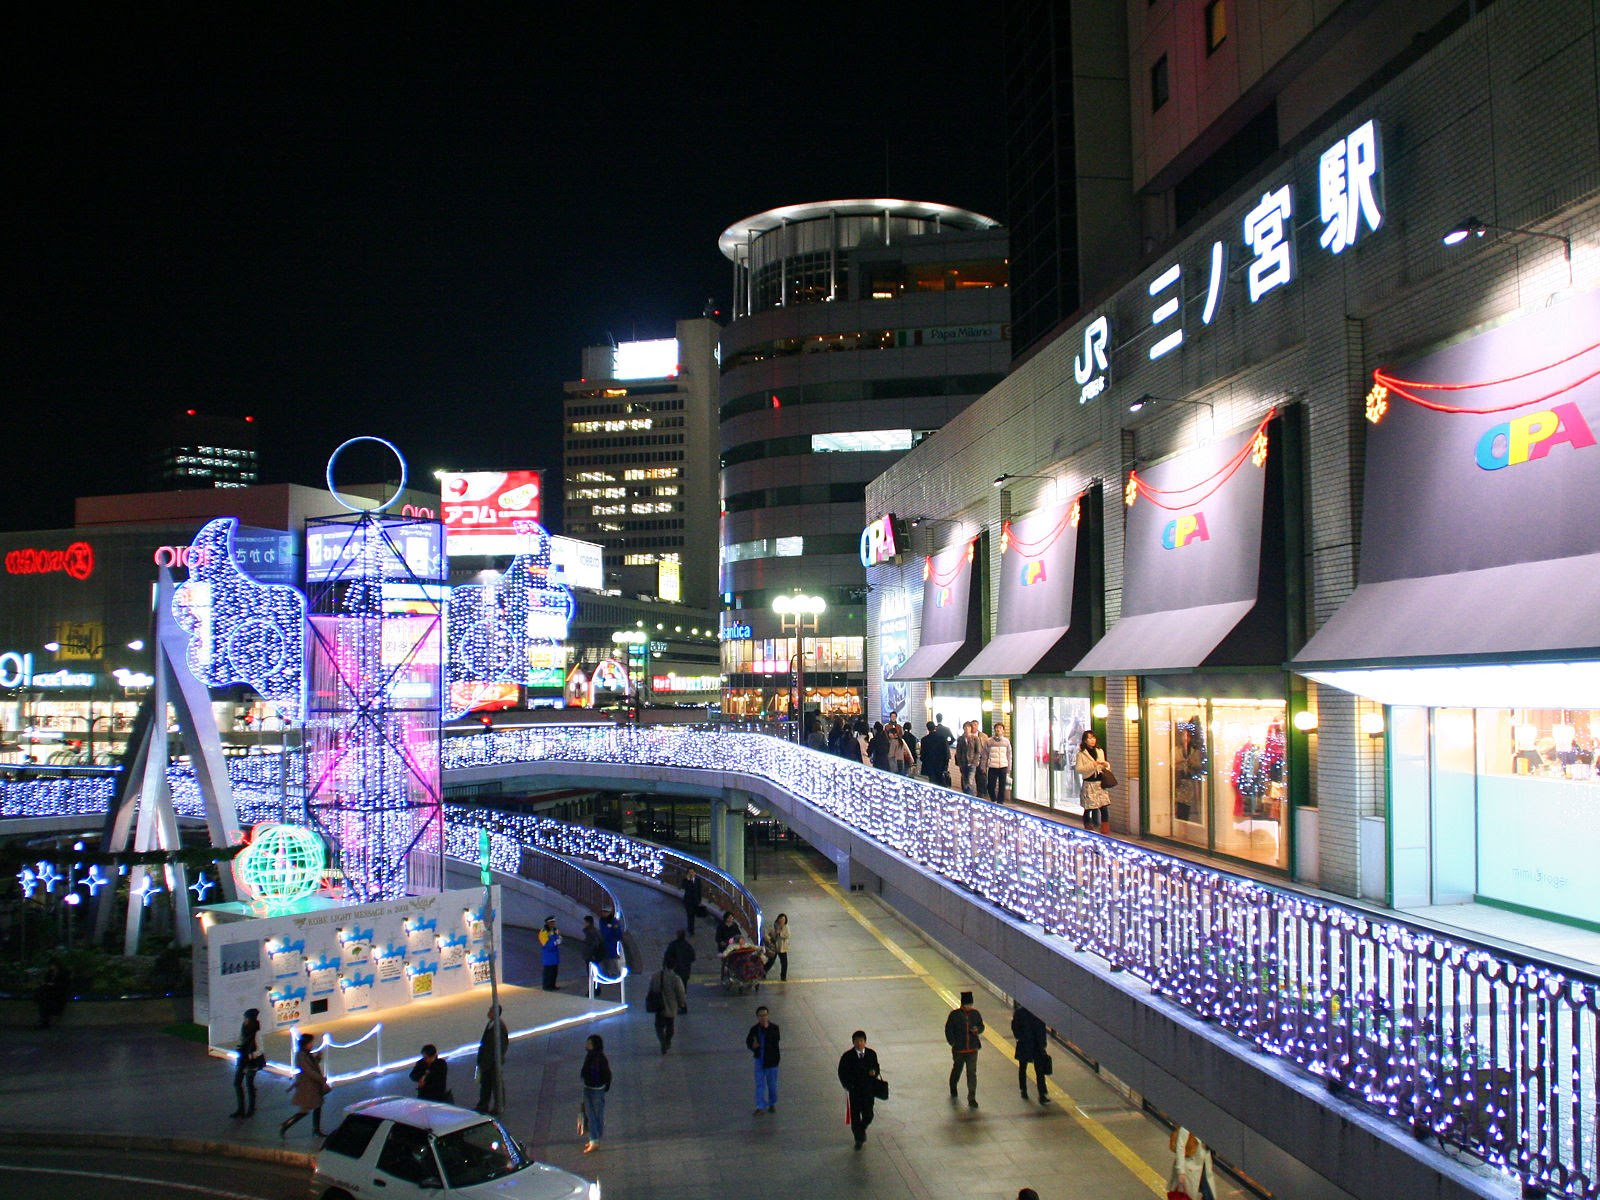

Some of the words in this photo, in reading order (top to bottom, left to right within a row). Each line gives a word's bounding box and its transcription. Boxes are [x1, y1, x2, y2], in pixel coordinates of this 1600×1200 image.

[1074, 315, 1109, 385] JR
[1149, 118, 1383, 361] 三ノ宮駅
[1473, 401, 1598, 471] OPA
[444, 505, 497, 524] アコム
[860, 513, 897, 568] OPA
[1161, 511, 1212, 551] OPA
[1020, 559, 1047, 586] OPA
[936, 587, 953, 609] OPA
[32, 673, 61, 687] KOBE
[330, 913, 352, 923] LIGHT
[354, 908, 384, 919] MESSAGE
